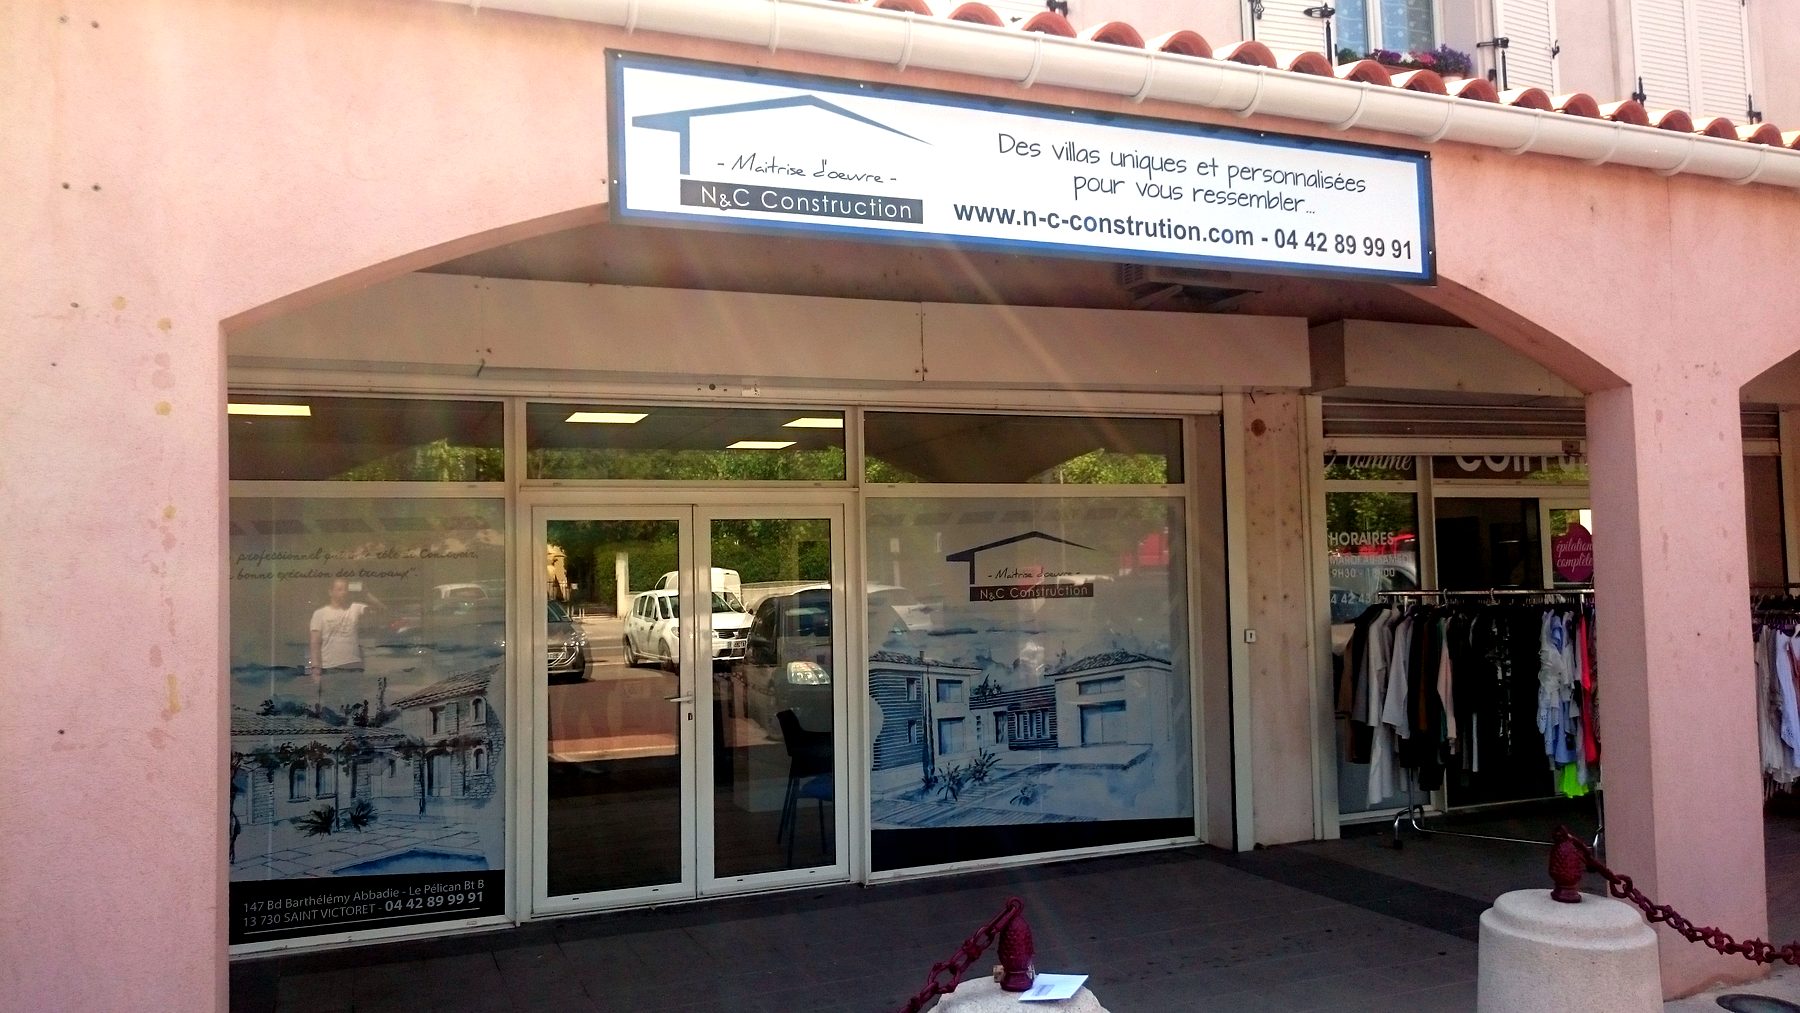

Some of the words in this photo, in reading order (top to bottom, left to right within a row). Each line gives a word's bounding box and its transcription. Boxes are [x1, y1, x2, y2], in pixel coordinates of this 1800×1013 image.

[813, 159, 883, 184] d'oeuvre
[998, 133, 1041, 158] Des
[1052, 141, 1101, 164] villas
[1110, 150, 1187, 180] uniques
[1197, 159, 1219, 177] et
[1227, 163, 1366, 193] personnalisées
[701, 186, 750, 208] N&C
[761, 190, 912, 220] Construction
[1073, 173, 1125, 200] pour
[1136, 179, 1184, 201] vous
[1192, 185, 1316, 215] ressembler...
[953, 203, 1254, 247] www.n-c-constrution.com
[1274, 228, 1298, 250] 04
[1304, 231, 1328, 253] 42
[1334, 233, 1357, 255] 89
[1363, 235, 1386, 257] 99
[1391, 238, 1413, 260] 91
[1330, 531, 1394, 546] HORAIRES
[980, 587, 1005, 601] N&C
[1010, 585, 1088, 598] Construction
[244, 901, 265, 914] 147
[267, 899, 282, 911] Bd
[285, 894, 350, 909] Barthélémy
[353, 887, 399, 901] Abbadie
[408, 885, 422, 896] Le
[424, 881, 461, 894] Pélican
[464, 880, 475, 891] Bt
[477, 878, 485, 889] B
[244, 916, 257, 927] 13
[261, 913, 281, 925] 730
[284, 909, 317, 923] SAINT
[321, 903, 375, 920] VICTORET
[385, 900, 403, 912] 04
[406, 897, 423, 910] 42
[426, 895, 444, 908] 89
[447, 893, 465, 906] 99
[468, 891, 484, 904] 91
